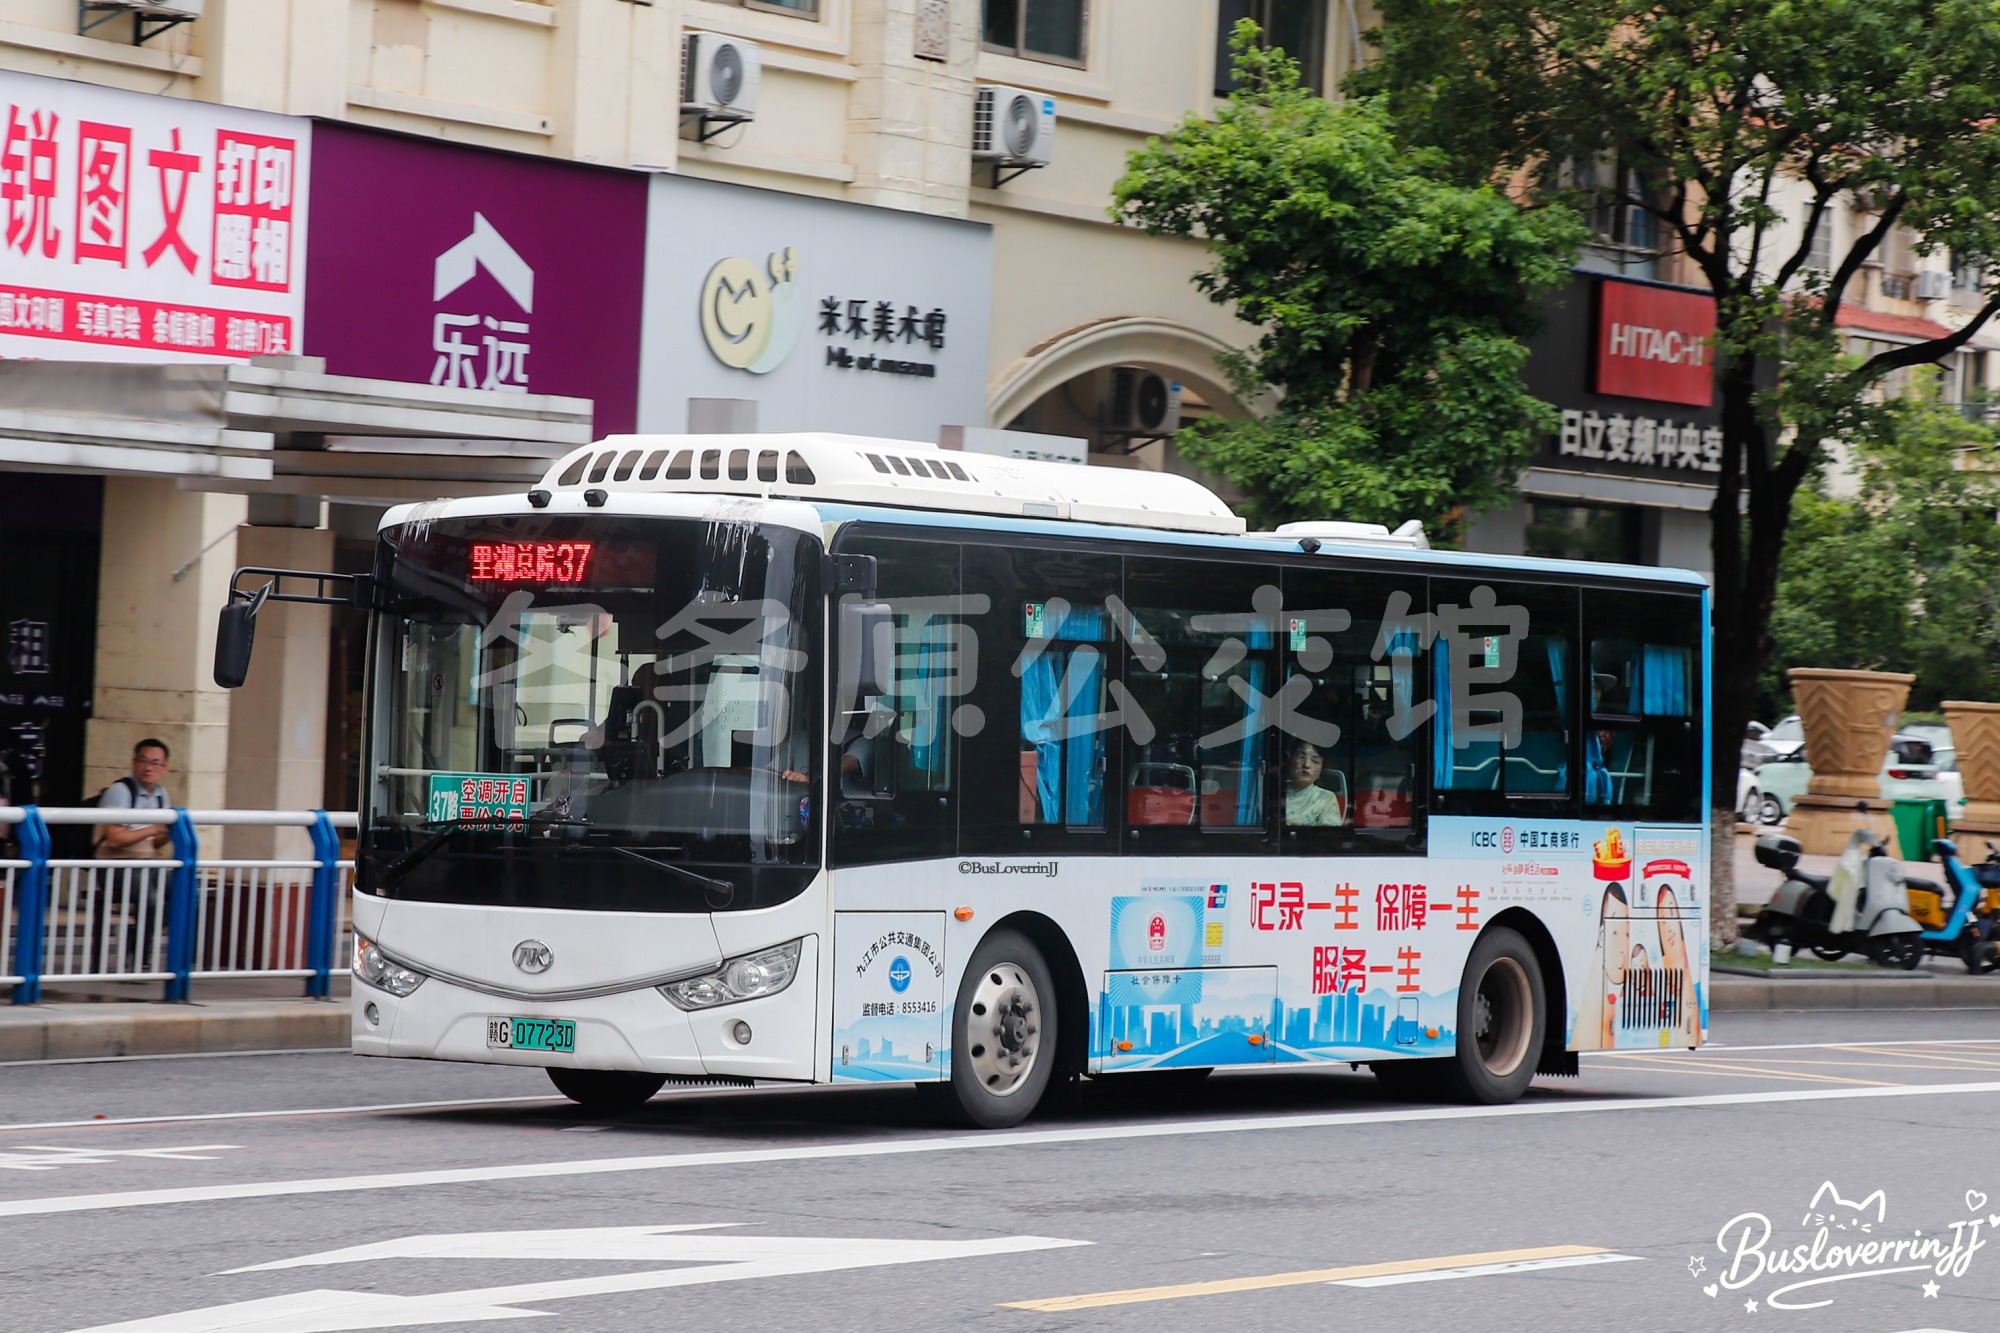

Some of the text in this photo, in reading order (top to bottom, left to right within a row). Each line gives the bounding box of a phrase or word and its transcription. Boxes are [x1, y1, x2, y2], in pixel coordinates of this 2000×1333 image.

[1, 104, 202, 276] 锐图文
[217, 139, 292, 211] 打印
[818, 295, 947, 350] 米乐美术馆
[1609, 322, 1704, 367] HITACHI
[429, 312, 531, 393] 乐远
[1559, 408, 1748, 476] 日立变频中央空
[431, 790, 459, 823] 37路
[461, 779, 526, 806] 空调开启
[1471, 830, 1580, 849] ICBC 中国工商银行
[1249, 881, 1480, 932] 记录一生 保障一生
[856, 931, 944, 978] 九江市公共交通集团公司
[1312, 945, 1422, 995] 服务一生
[1131, 974, 1182, 986] 社会保障卡
